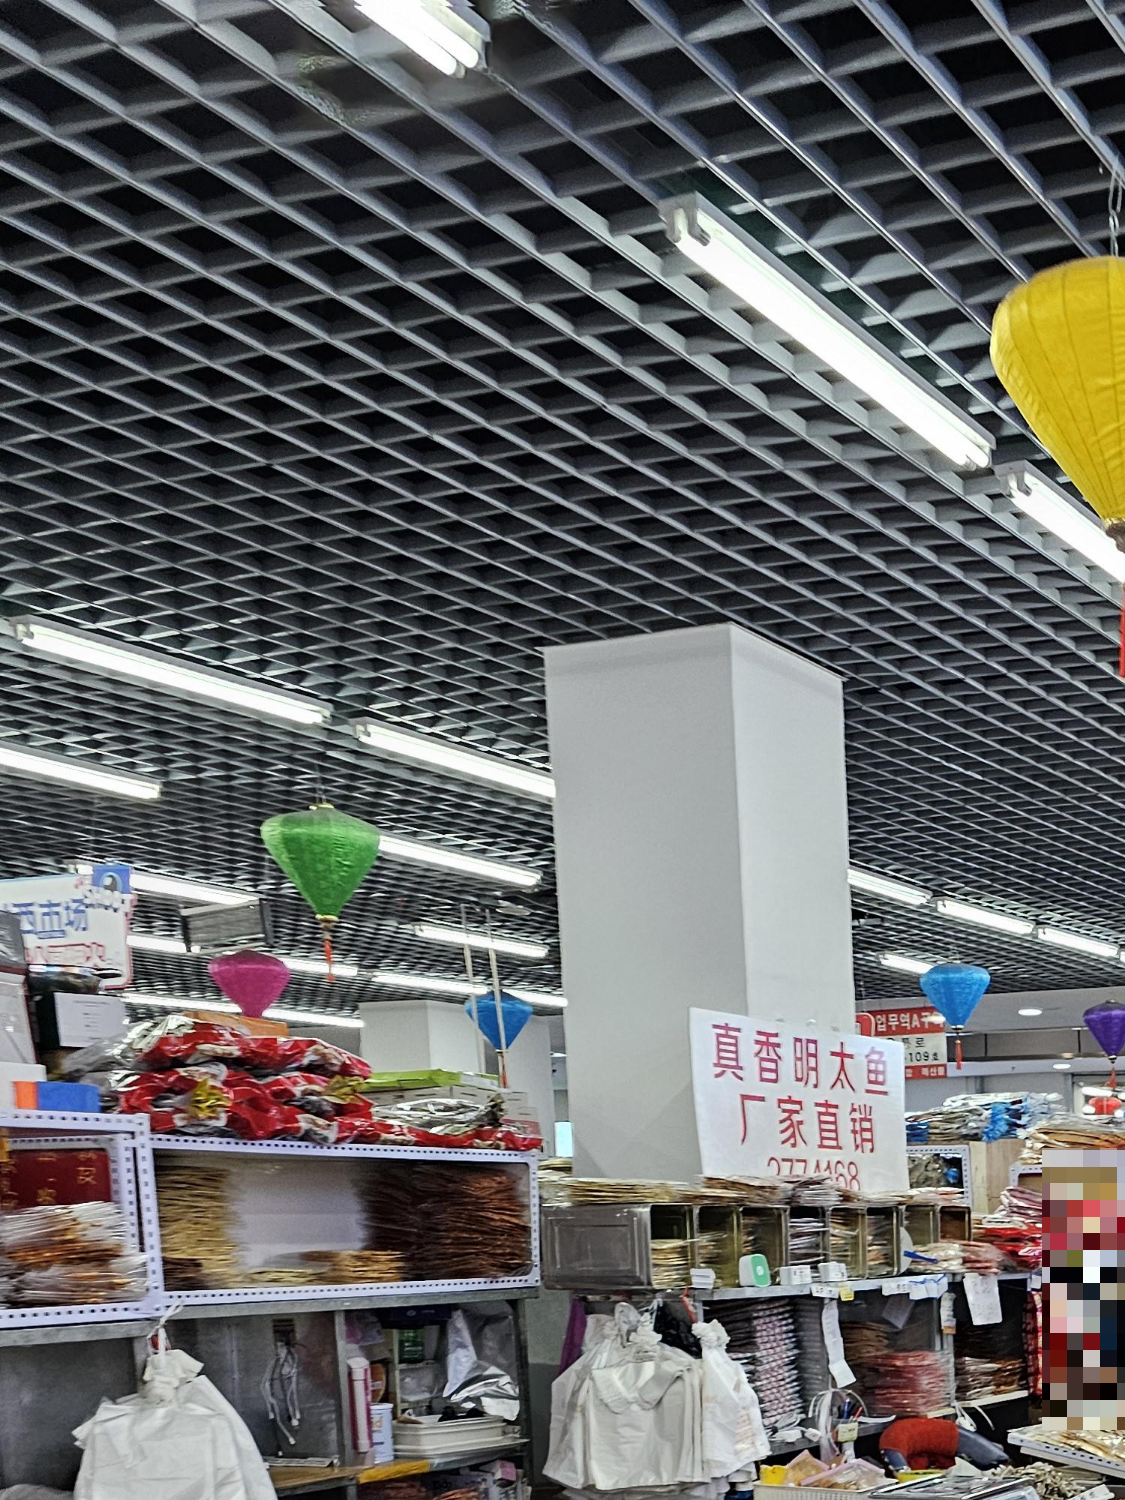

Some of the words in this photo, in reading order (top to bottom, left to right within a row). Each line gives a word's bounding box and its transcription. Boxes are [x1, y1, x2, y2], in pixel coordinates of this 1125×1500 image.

[711, 1023, 889, 1096] 真香明太鱼
[739, 1093, 875, 1154] 厂家直销
